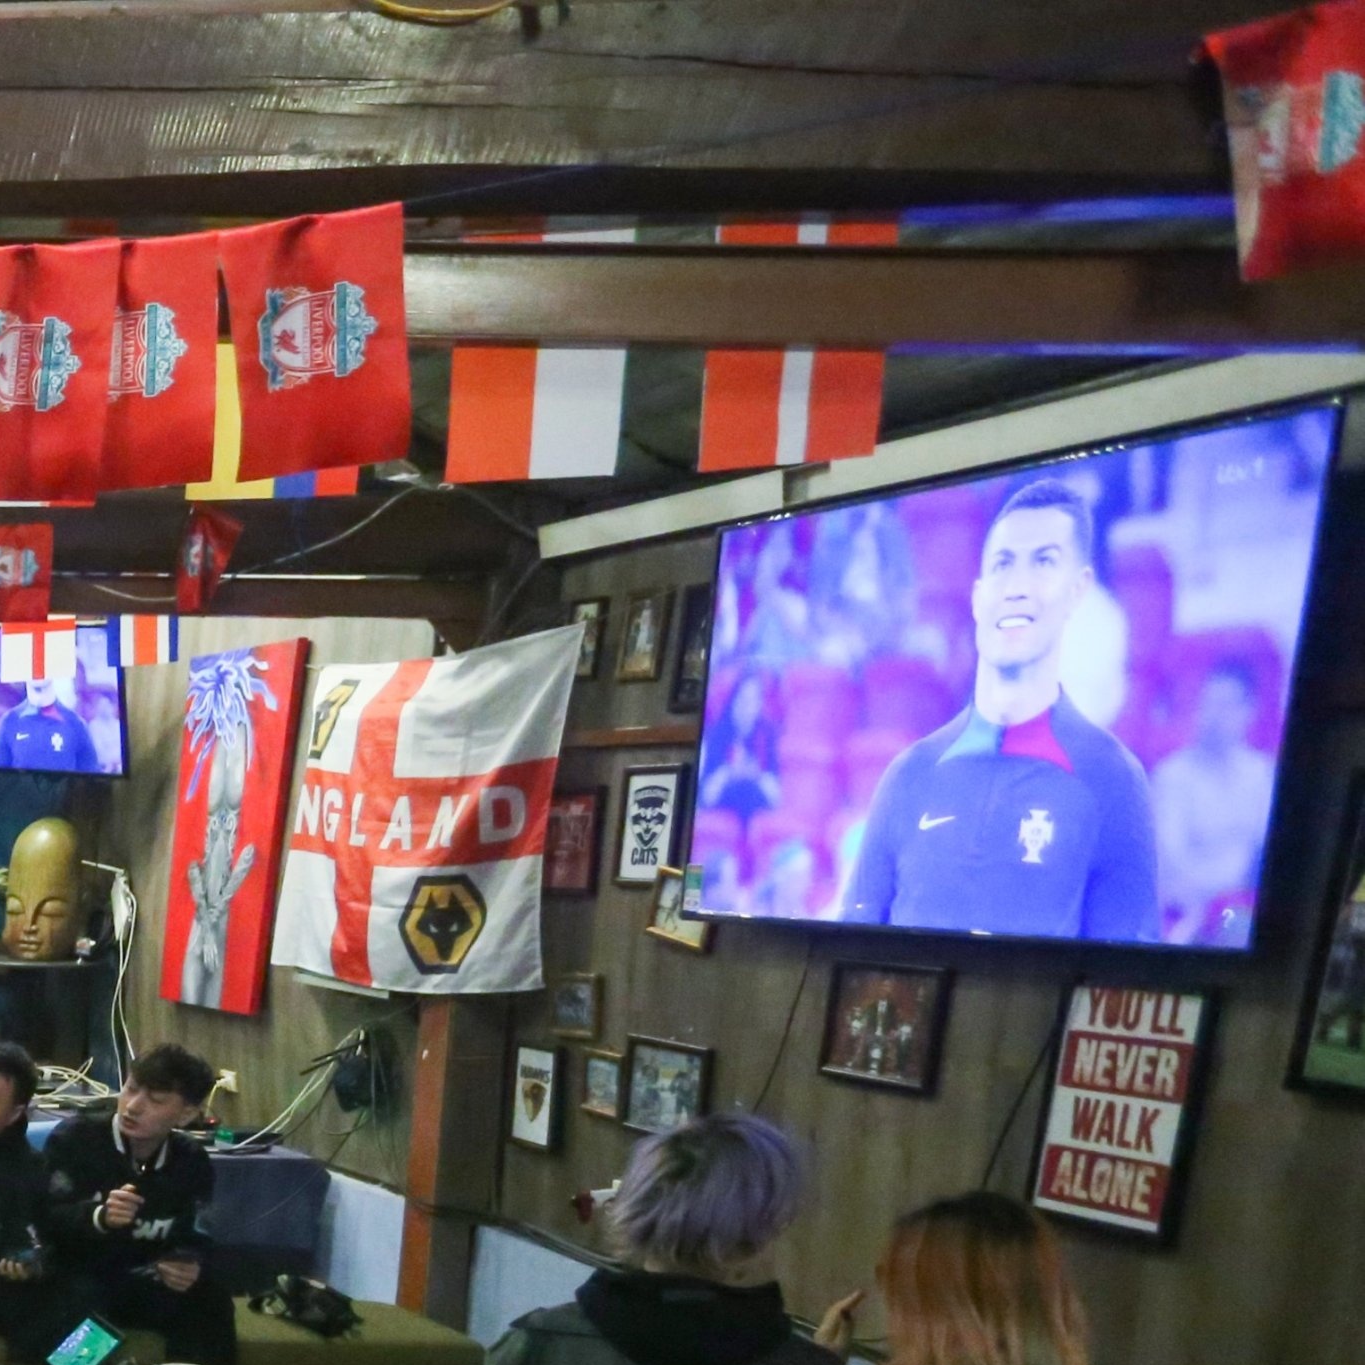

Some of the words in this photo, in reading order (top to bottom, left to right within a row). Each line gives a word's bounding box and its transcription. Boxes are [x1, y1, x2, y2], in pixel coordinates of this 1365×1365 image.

[15, 331, 32, 396] LIVERPOOL
[122, 320, 135, 385] LIVERPOOL
[311, 300, 324, 367] LIVERPOOL
[293, 783, 527, 851] NGLAND
[631, 847, 659, 866] CATS
[1088, 988, 1184, 1035] YOU'LL
[1073, 1038, 1180, 1096] NEVER
[1072, 1097, 1161, 1152] WALK
[1051, 1152, 1156, 1213] ALONE
